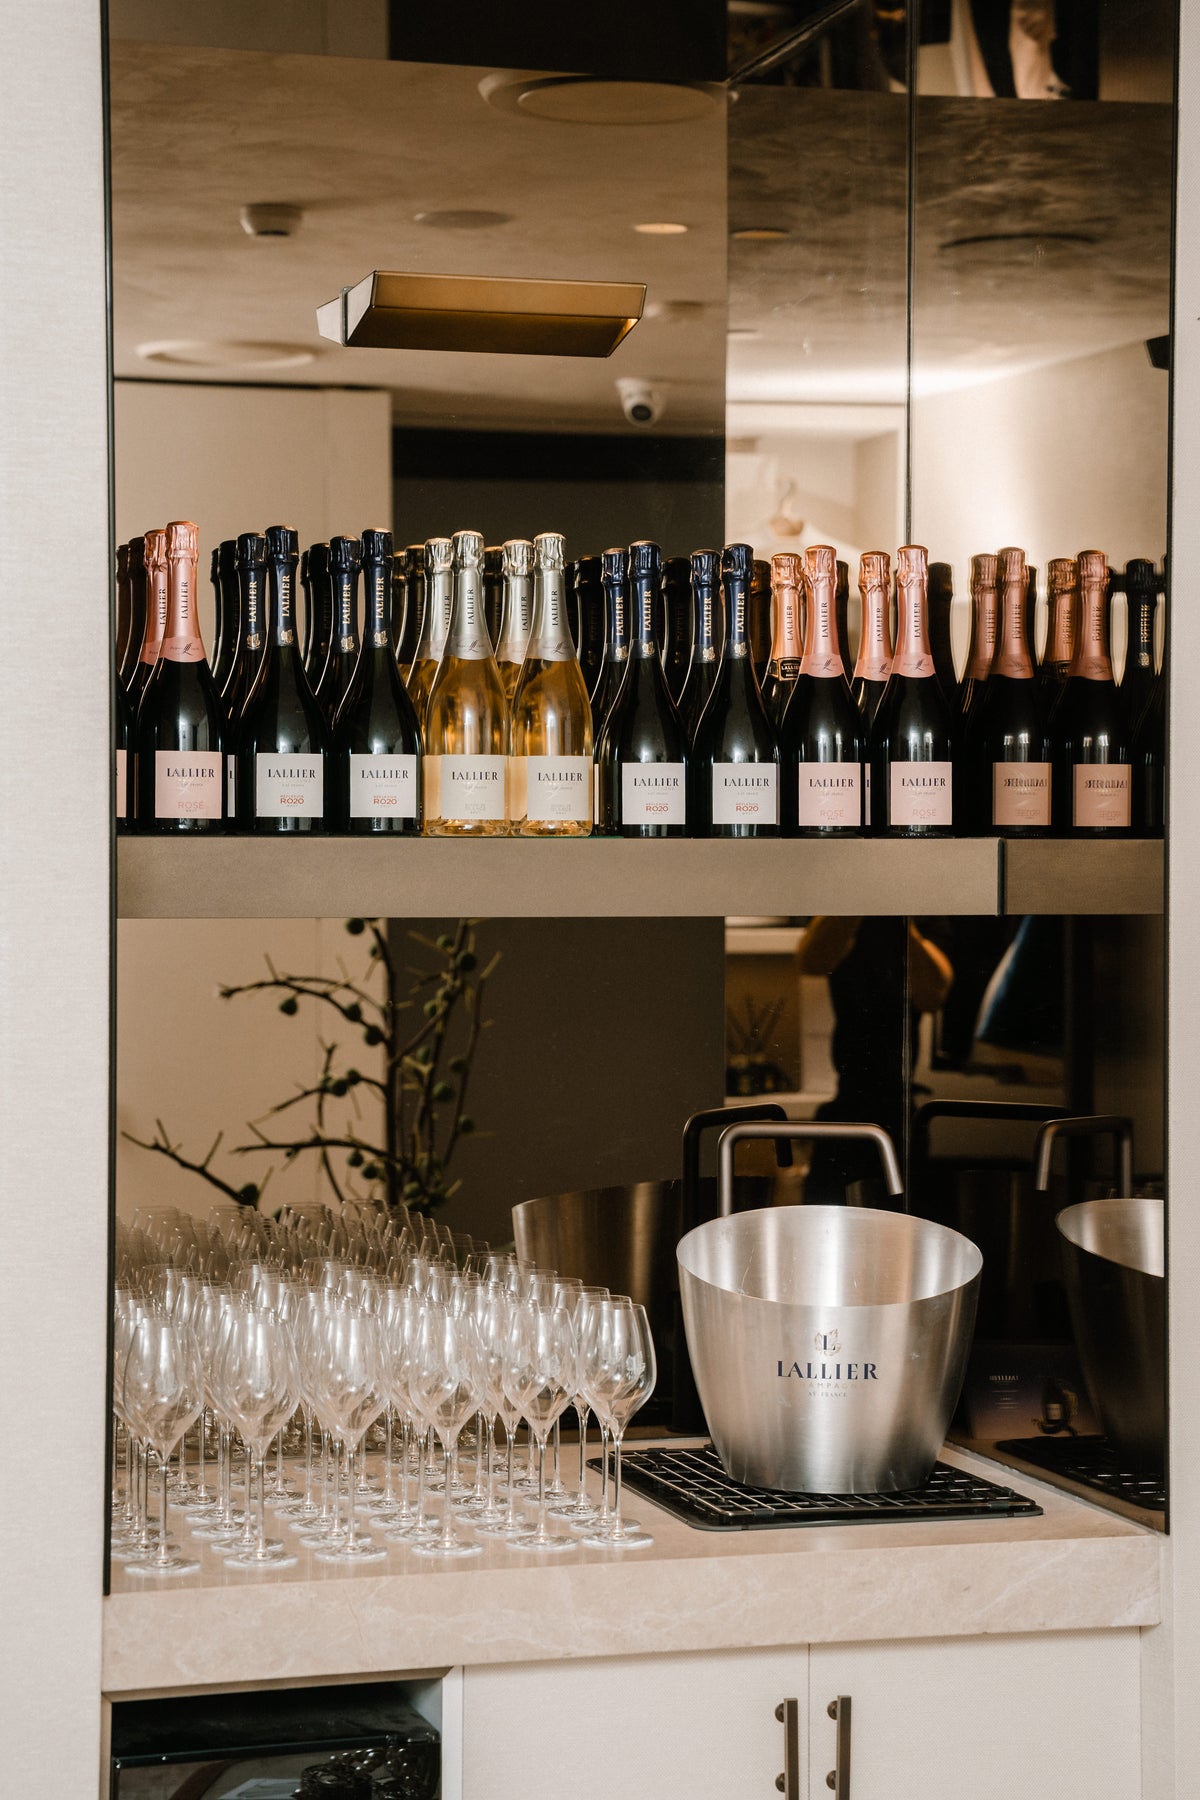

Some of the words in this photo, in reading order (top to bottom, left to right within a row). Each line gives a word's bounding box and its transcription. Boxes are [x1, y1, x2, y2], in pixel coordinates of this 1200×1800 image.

[248, 580, 257, 622] LALLIER
[282, 575, 290, 617] LALLIER
[375, 576, 384, 619] LALLIER
[342, 583, 351, 625] LALLIER
[551, 590, 559, 626] LALLIER
[643, 590, 651, 631] LALLIER
[615, 596, 624, 636] LALLIER
[704, 597, 712, 637] LALLIER
[737, 592, 745, 633] LALLIER
[821, 602, 829, 638] LALLIER
[167, 768, 215, 778] LALLIER
[268, 768, 316, 779] LALLIER
[361, 769, 409, 779] LALLIER
[452, 771, 498, 781] LALLIER
[538, 772, 583, 781] LALLIER
[633, 778, 680, 787] LALLIER
[724, 778, 770, 787] LALLIER
[809, 778, 854, 788] LALLIER
[902, 778, 946, 787] LALLIER
[177, 800, 204, 810] ROSÉ
[819, 808, 844, 817] ROSÉ
[912, 808, 936, 817] ROSÉ
[823, 1335, 836, 1350] L
[777, 1360, 879, 1380] LALLIER
